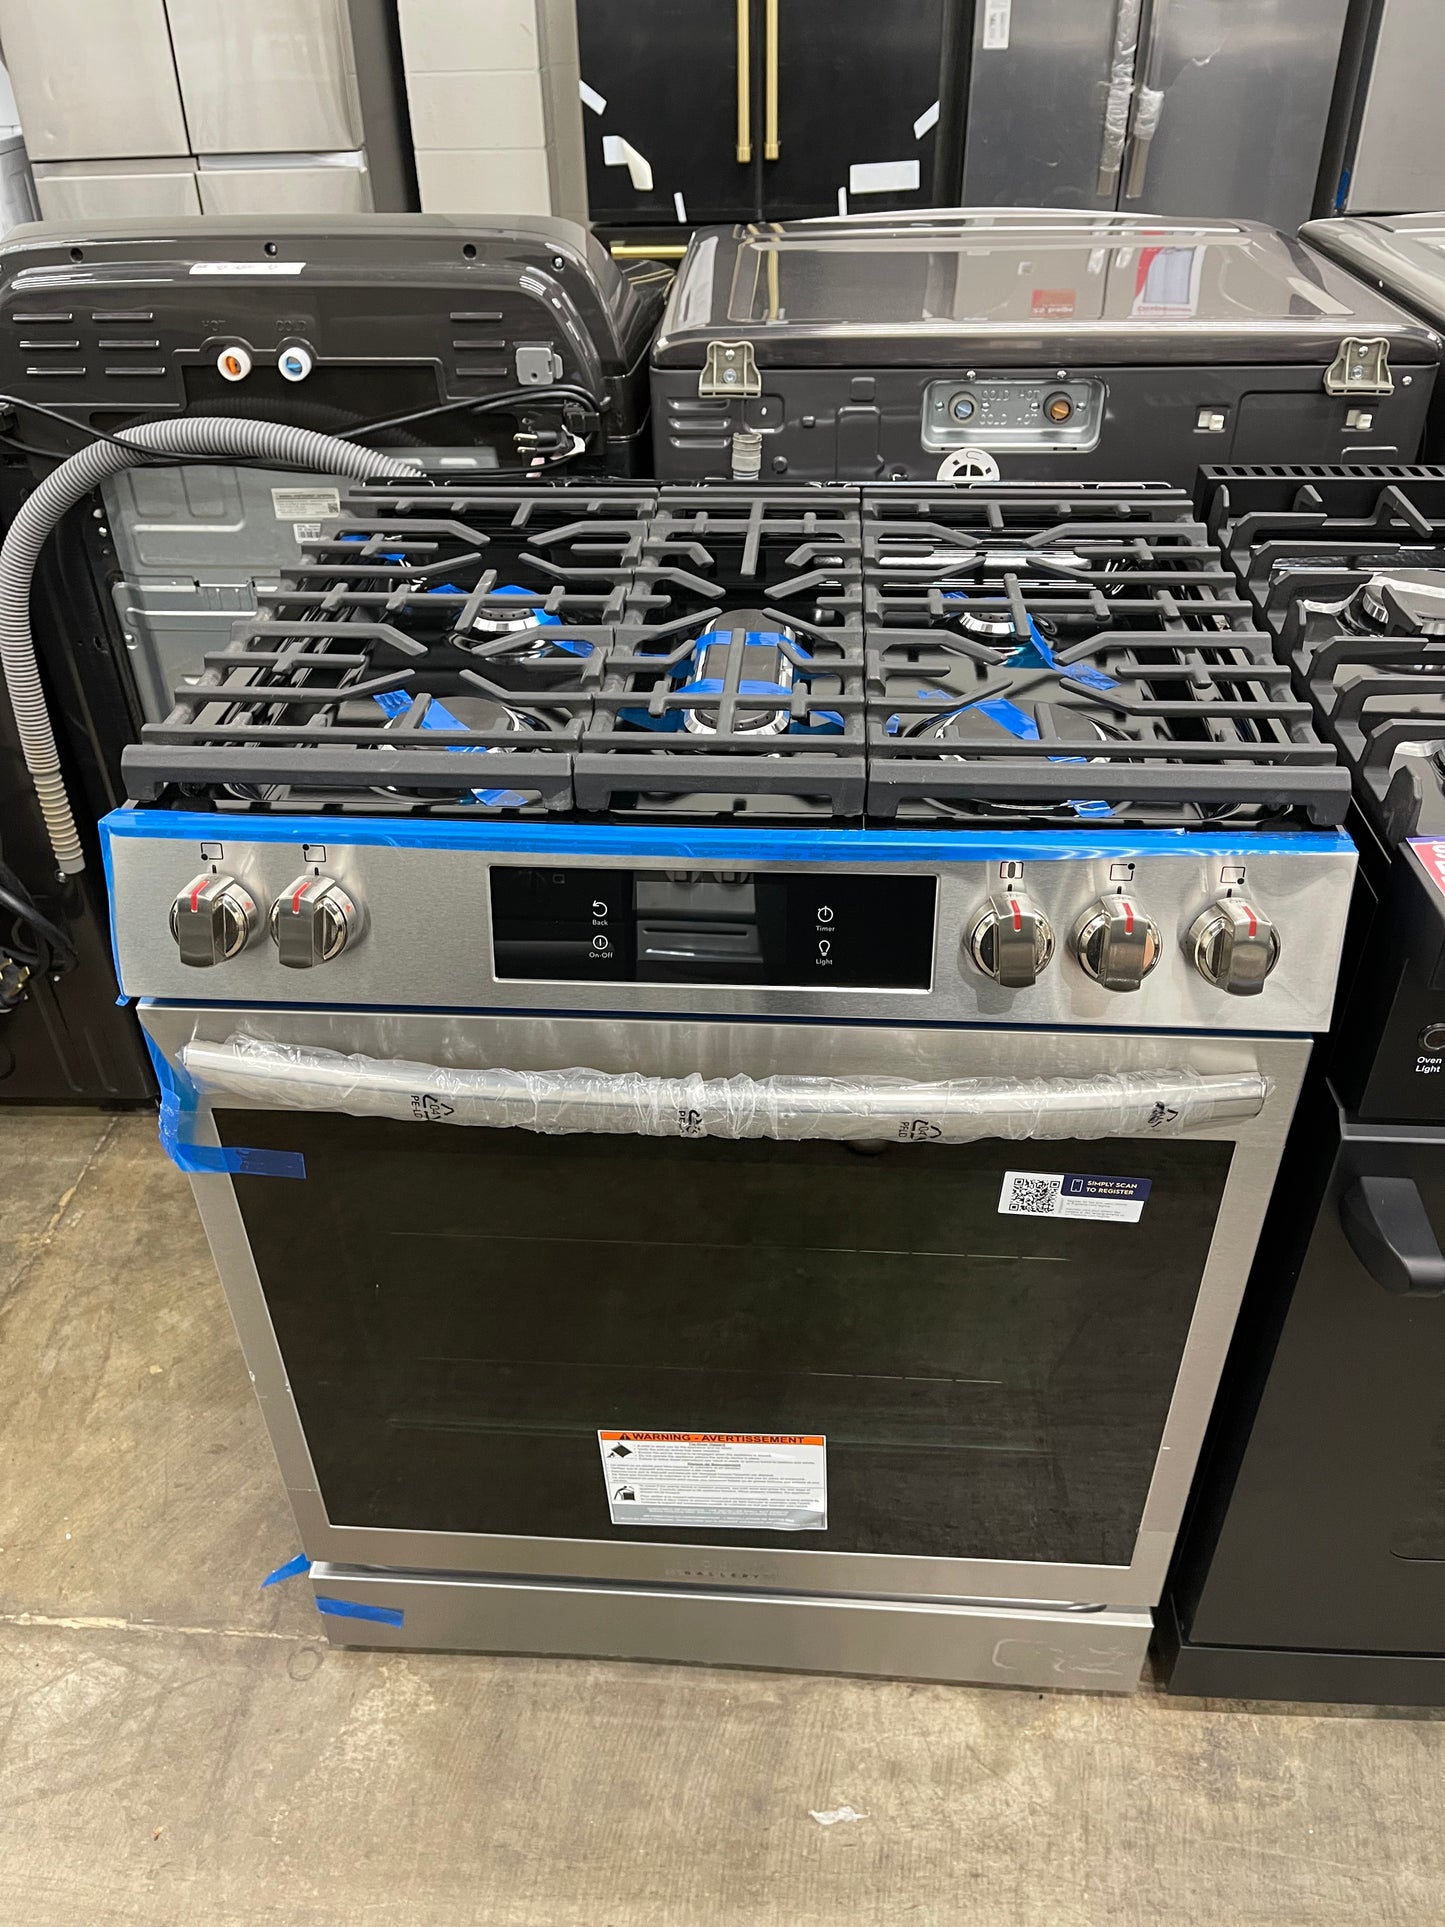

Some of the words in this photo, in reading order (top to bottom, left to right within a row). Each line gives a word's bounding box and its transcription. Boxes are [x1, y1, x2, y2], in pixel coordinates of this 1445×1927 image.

[815, 958, 834, 966] Light
[1416, 1056, 1443, 1064] Oven
[1415, 1065, 1441, 1074] Light
[1087, 1180, 1115, 1188] SIMPLY
[1098, 1187, 1134, 1196] REGISTER
[632, 1432, 691, 1441] WARNING
[702, 1433, 805, 1445] AVERTISSEMENT
